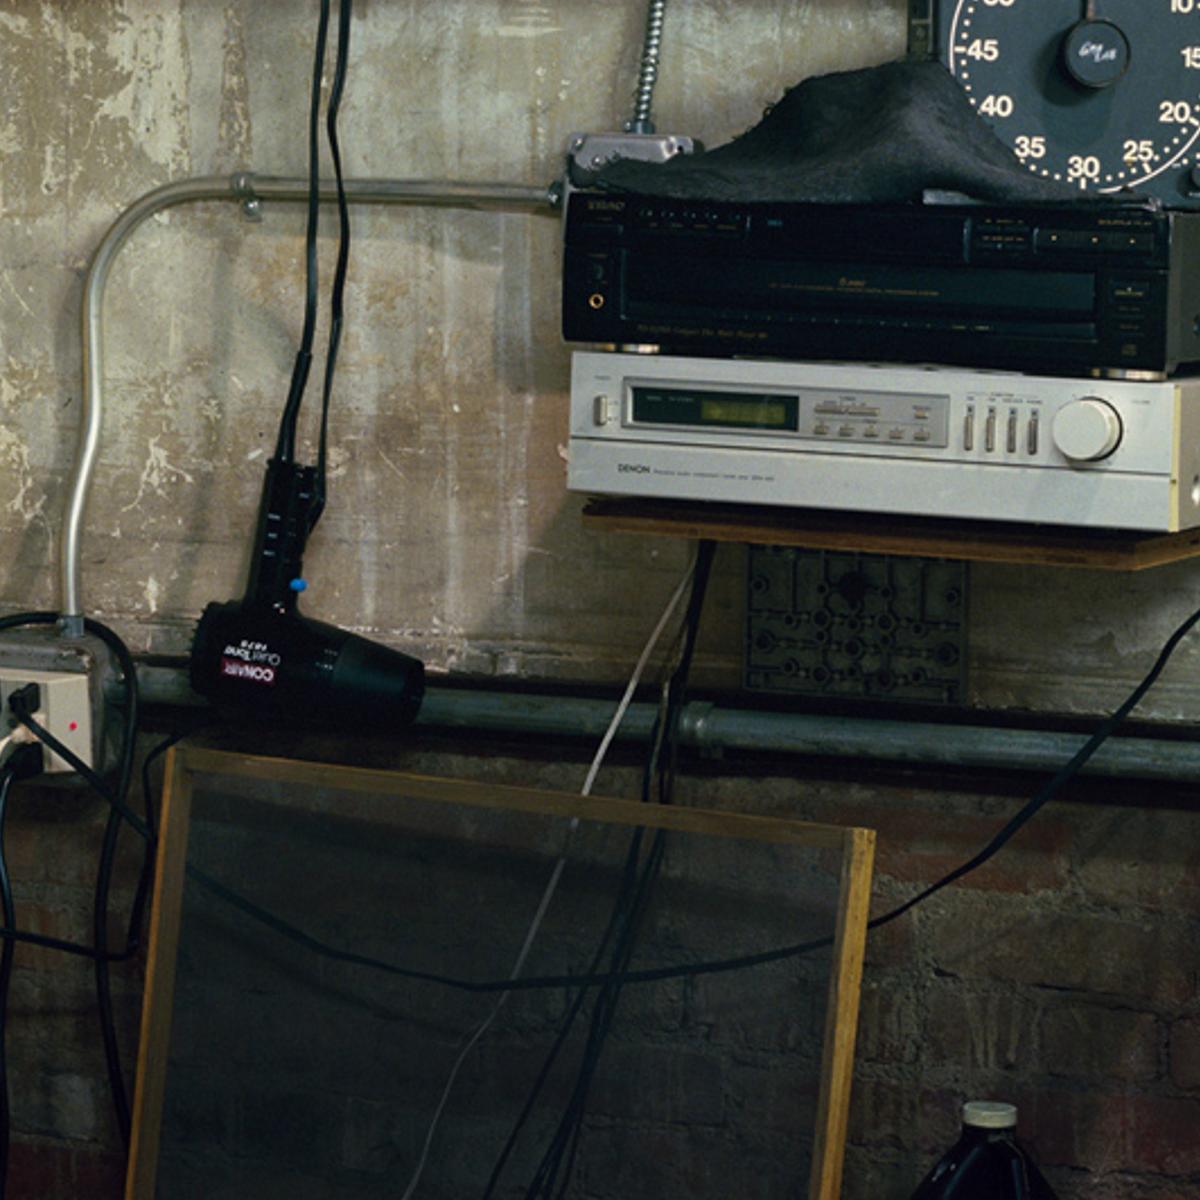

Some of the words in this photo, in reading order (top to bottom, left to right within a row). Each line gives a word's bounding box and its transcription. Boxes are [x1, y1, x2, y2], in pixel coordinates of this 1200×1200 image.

[967, 40, 999, 61] 45
[980, 96, 1013, 117] 40
[1159, 102, 1191, 123] 20
[1014, 136, 1046, 158] 35
[1123, 140, 1154, 162] 25
[1067, 157, 1100, 178] 30
[617, 463, 650, 475] DENON
[224, 662, 274, 682] CONAIR
